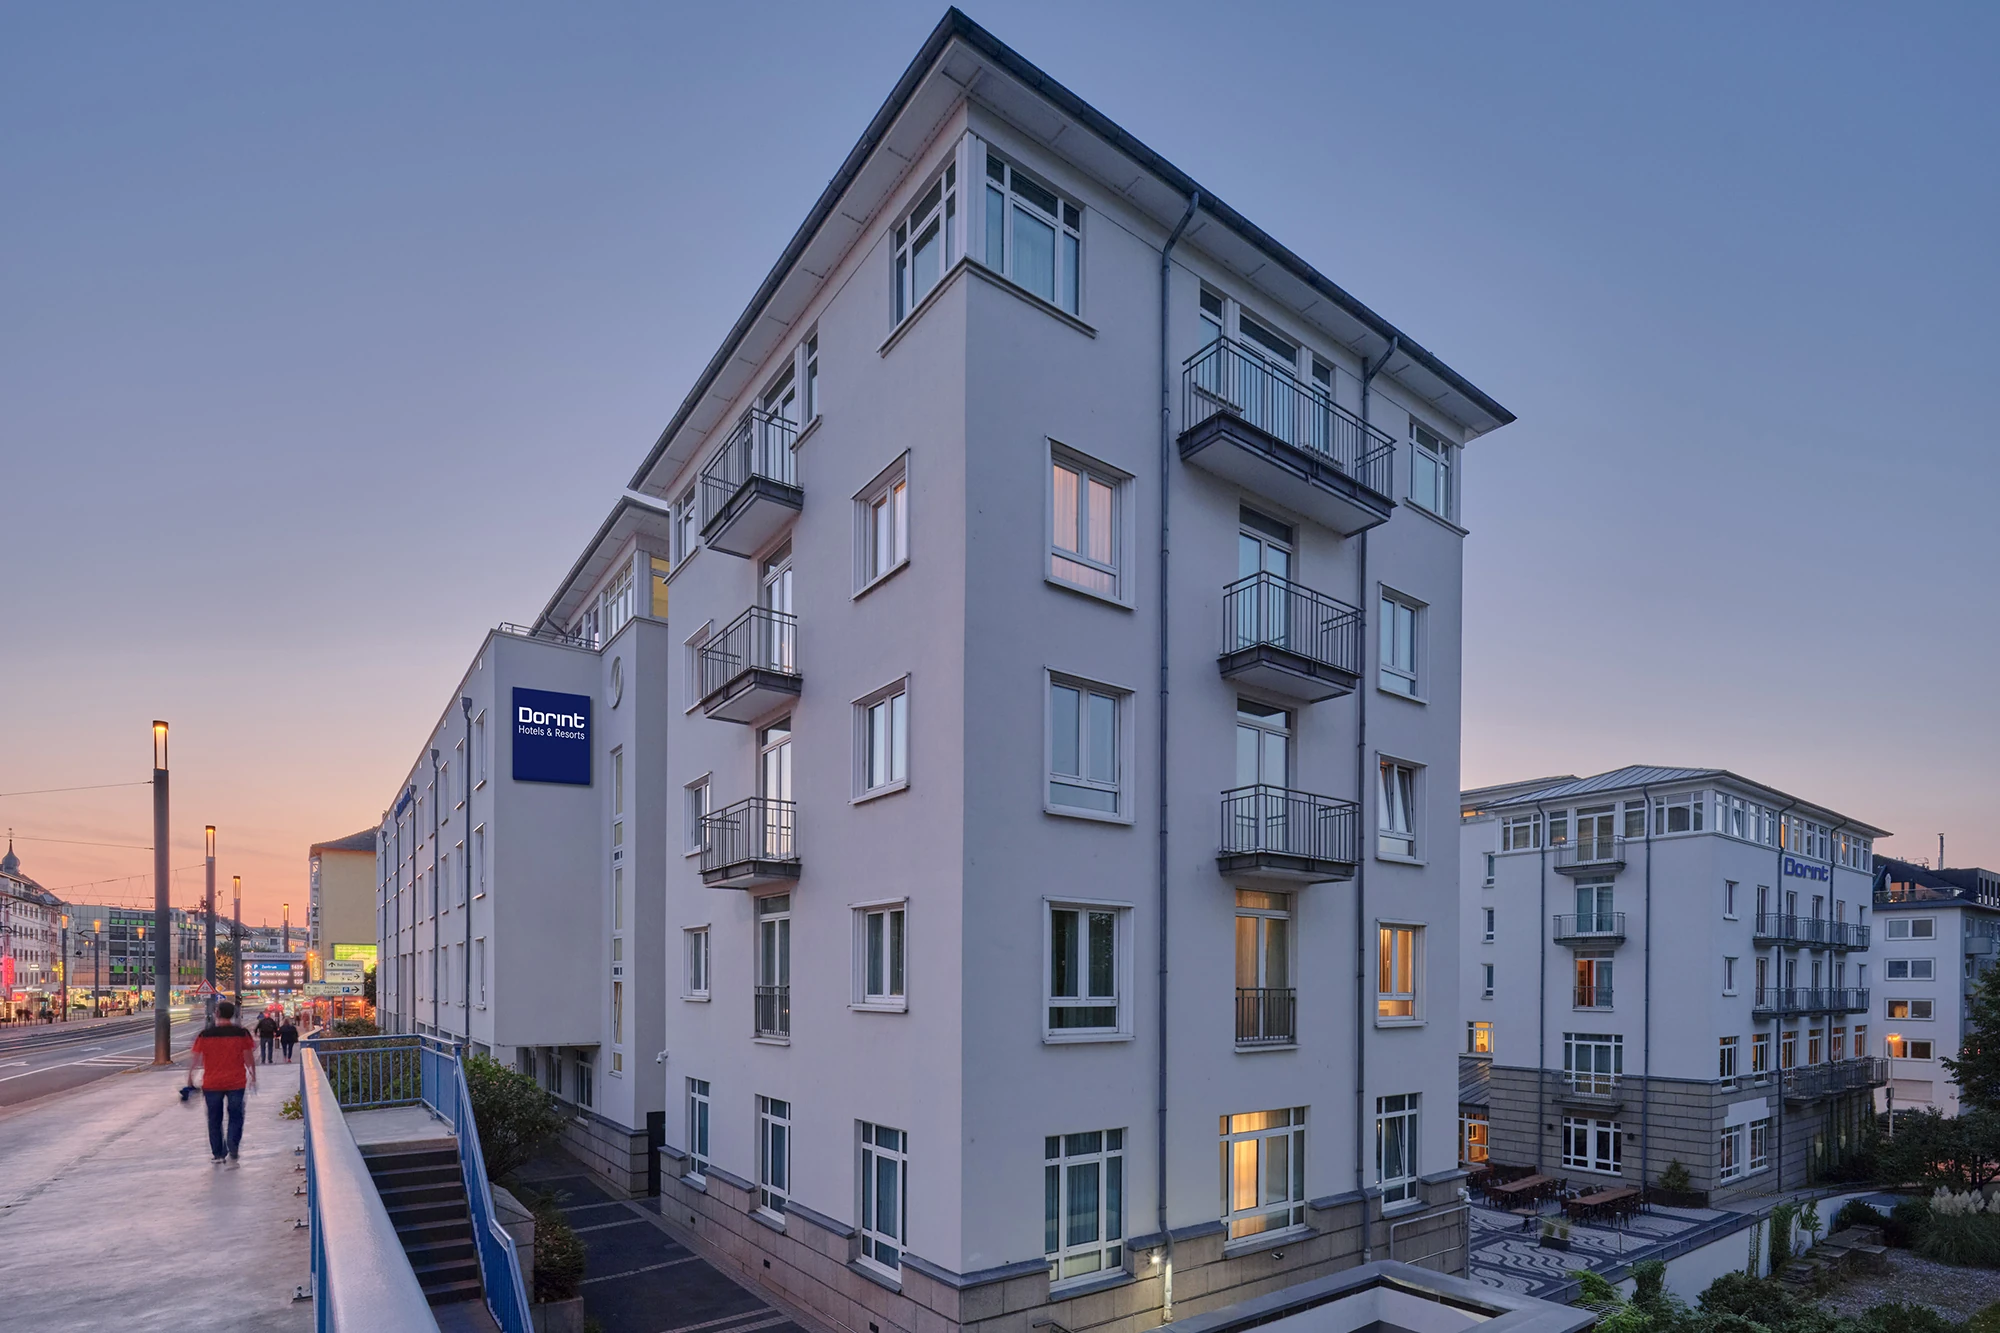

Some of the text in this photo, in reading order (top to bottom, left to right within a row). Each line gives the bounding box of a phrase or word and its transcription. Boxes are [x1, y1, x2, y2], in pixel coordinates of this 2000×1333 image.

[518, 706, 585, 729] Dorint
[518, 725, 585, 740] Hotels & Resorts
[1784, 857, 1829, 882] Dorint
